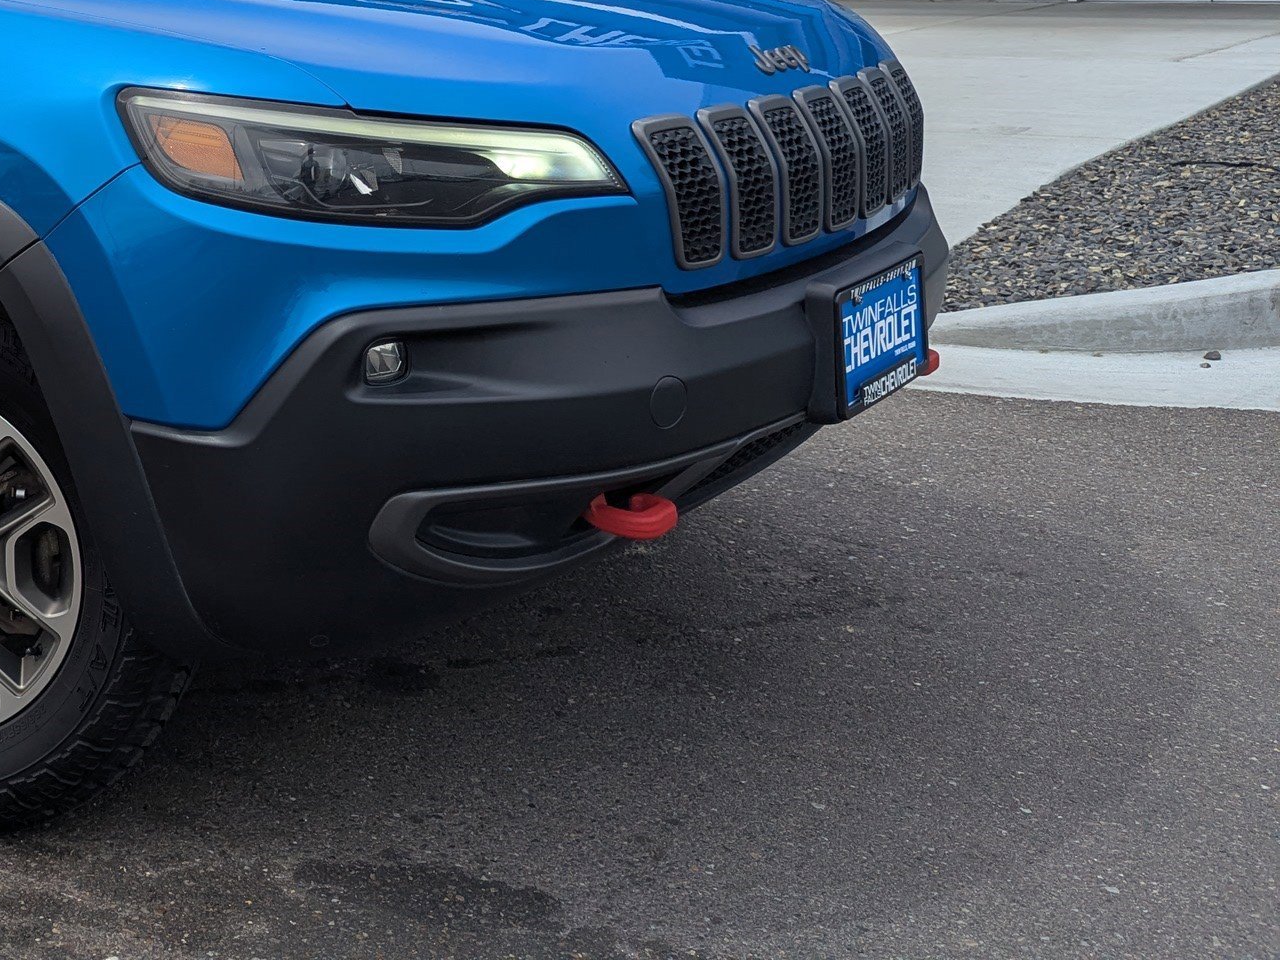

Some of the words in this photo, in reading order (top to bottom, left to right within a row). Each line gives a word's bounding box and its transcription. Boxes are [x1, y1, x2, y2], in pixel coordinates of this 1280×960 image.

[748, 44, 810, 74] Jeep
[842, 284, 917, 337] TWINFALLS
[843, 304, 917, 373] CHEVROLET
[880, 357, 917, 396] CHEVROLET
